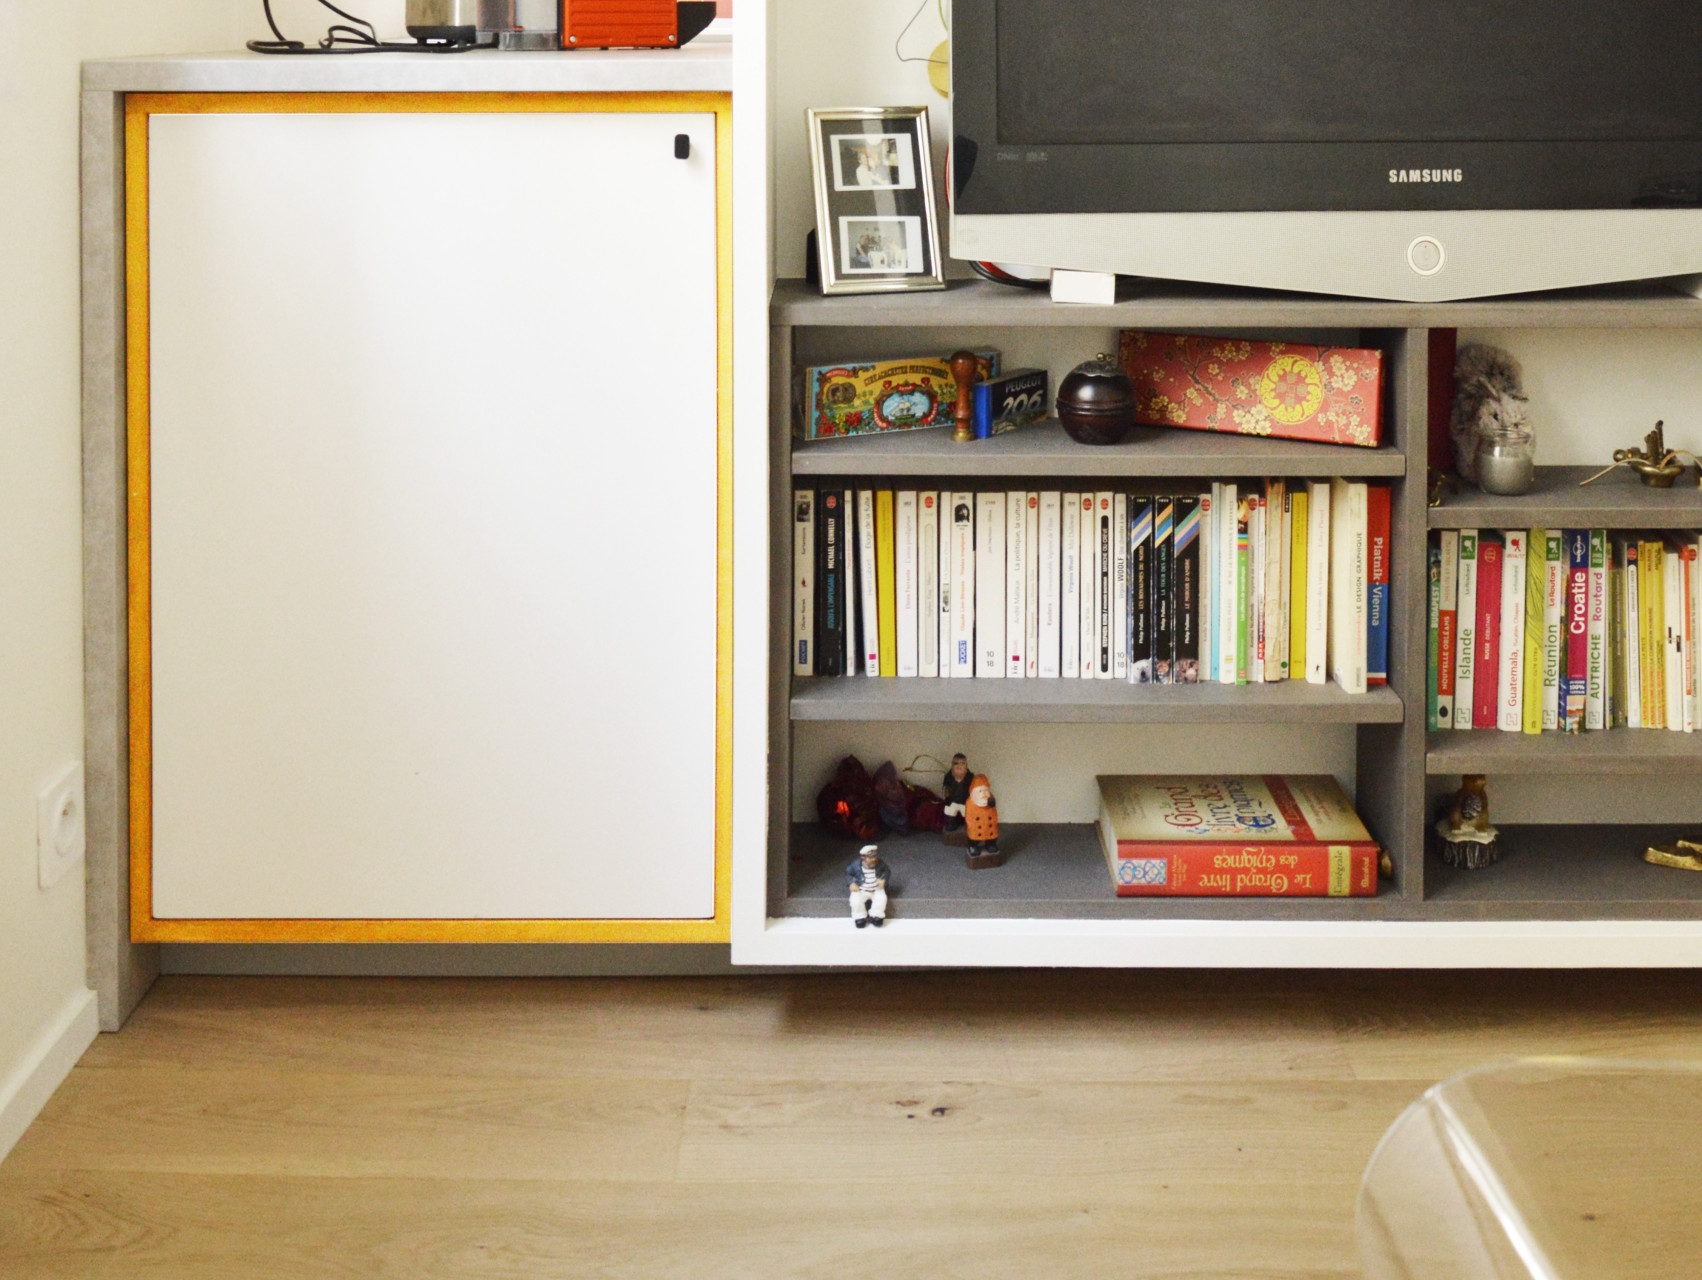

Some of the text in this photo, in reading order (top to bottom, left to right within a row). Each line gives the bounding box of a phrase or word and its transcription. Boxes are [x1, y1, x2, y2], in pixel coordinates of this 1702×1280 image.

[1389, 169, 1463, 183] SAMSUNG
[1005, 376, 1042, 394] PEUGEOT
[1001, 390, 1044, 419] 206
[865, 520, 871, 530] de
[827, 517, 835, 570] MICHAEL CONNELLY
[1014, 530, 1022, 562] politique,
[1014, 563, 1020, 571] La
[1117, 556, 1125, 582] WOOLF
[1160, 588, 1166, 596] LA
[1371, 537, 1384, 627] Platnik Vienna
[1184, 602, 1190, 610] LE
[1356, 605, 1362, 613] LE
[1430, 585, 1439, 629] BUDAPEST
[1570, 571, 1586, 635] Croatie
[1593, 572, 1602, 622] Routard
[958, 640, 967, 664] POCKET
[986, 660, 995, 668] 18
[1442, 616, 1450, 690] NOUVELLE ORLÉANS
[1458, 628, 1472, 680] Islande
[1544, 624, 1557, 687] Réunion
[1507, 649, 1519, 707] Guatemala,
[1590, 634, 1601, 700] AUTRICHE
[1155, 785, 1203, 827] Grand
[1213, 847, 1298, 870] des énigmes
[1199, 872, 1313, 893] Le Grand livre
